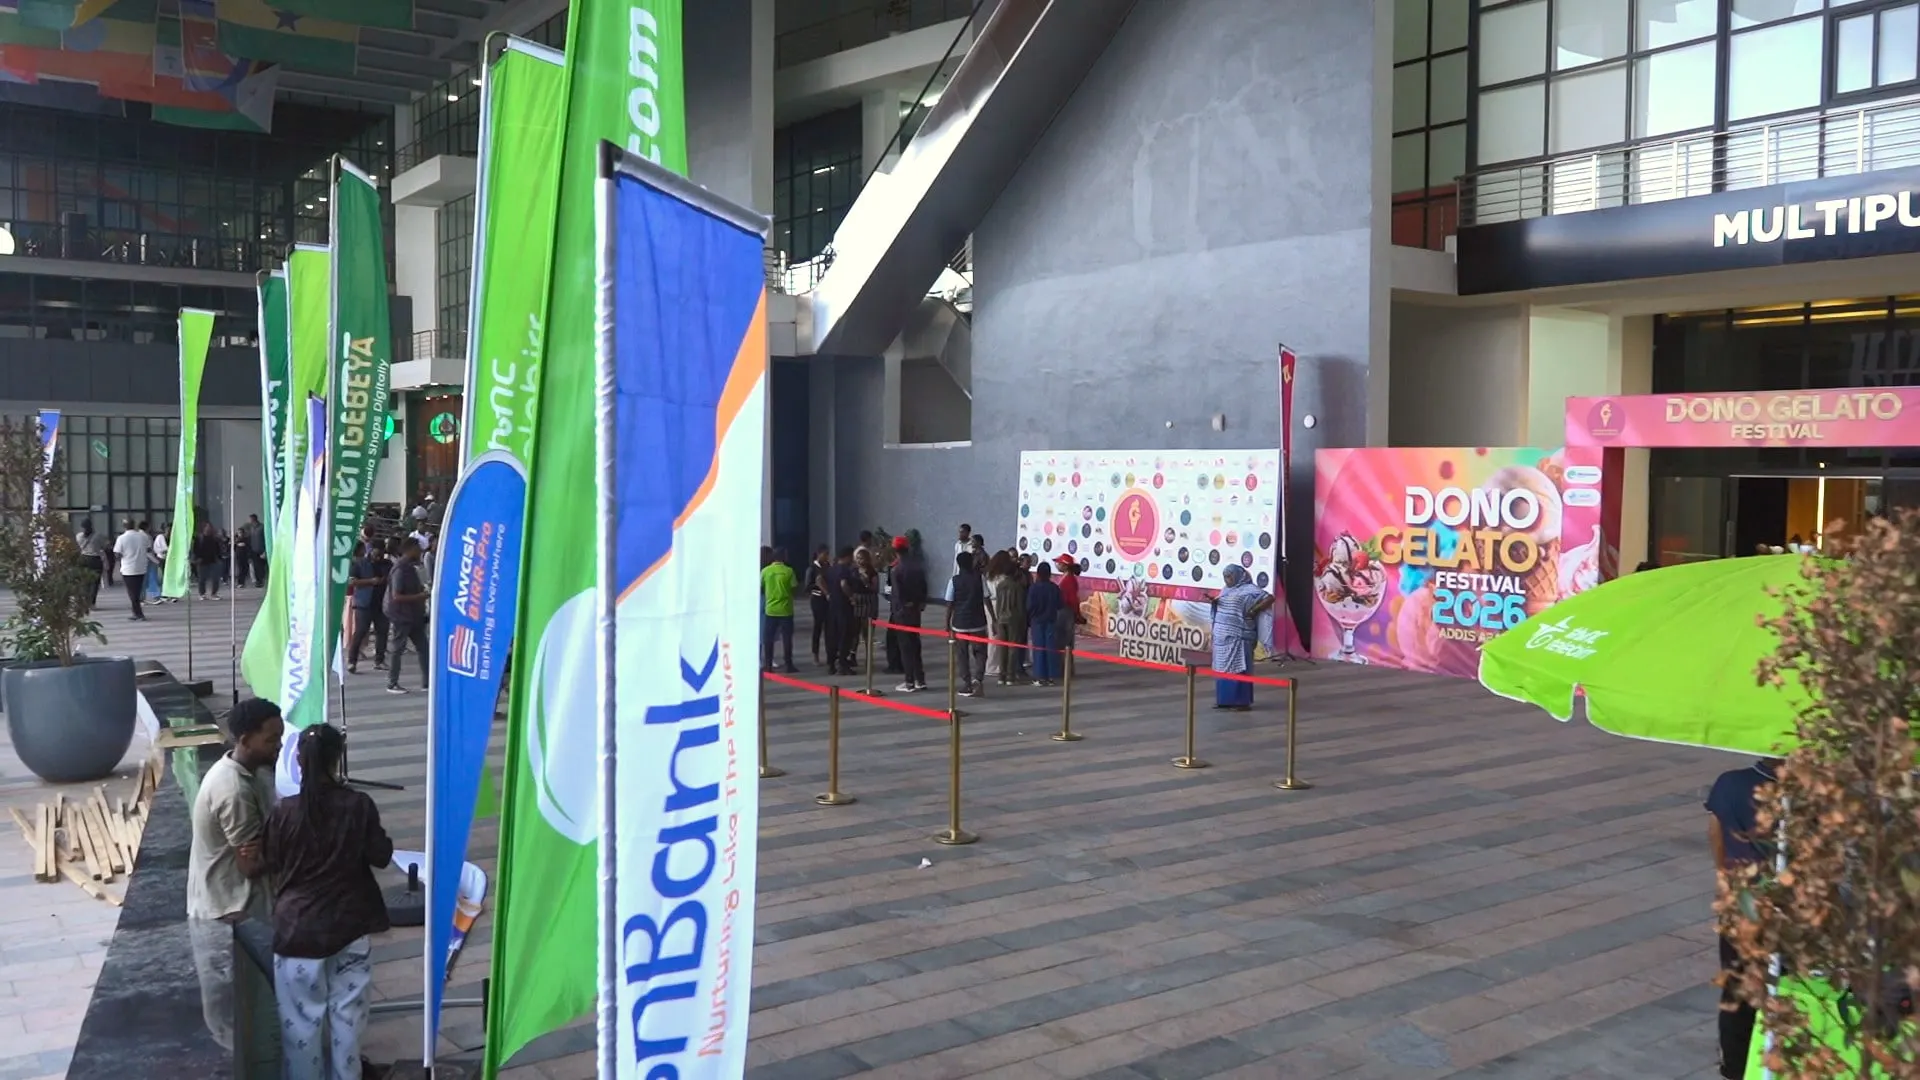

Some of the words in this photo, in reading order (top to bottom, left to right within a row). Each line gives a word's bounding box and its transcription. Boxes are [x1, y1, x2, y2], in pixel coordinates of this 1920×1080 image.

[1713, 191, 1920, 248] MULTIPU
[372, 358, 389, 413] Digitally
[1666, 396, 1761, 423] DONO
[1767, 392, 1903, 421] GELATO
[367, 415, 382, 456] Shops
[1730, 423, 1824, 440] FESTIVAL
[1404, 486, 1540, 529] DONO
[453, 526, 478, 616] Awash
[468, 521, 494, 622] BIRR-Pro
[486, 523, 506, 613] Everywhere
[1378, 527, 1538, 573] GELATO
[1432, 589, 1528, 630] 2026
[1435, 571, 1526, 595] FESTIVAL
[480, 617, 496, 680] Banking
[1108, 618, 1145, 639] DONO
[1149, 623, 1203, 648] GELATO
[1121, 638, 1184, 666] FESTIVAL
[1438, 627, 1476, 642] ADDIS
[719, 639, 736, 727] River
[724, 738, 738, 806] The
[622, 634, 720, 1080] nBank
[721, 812, 739, 885] Like
[697, 888, 740, 1057] Nurturing
